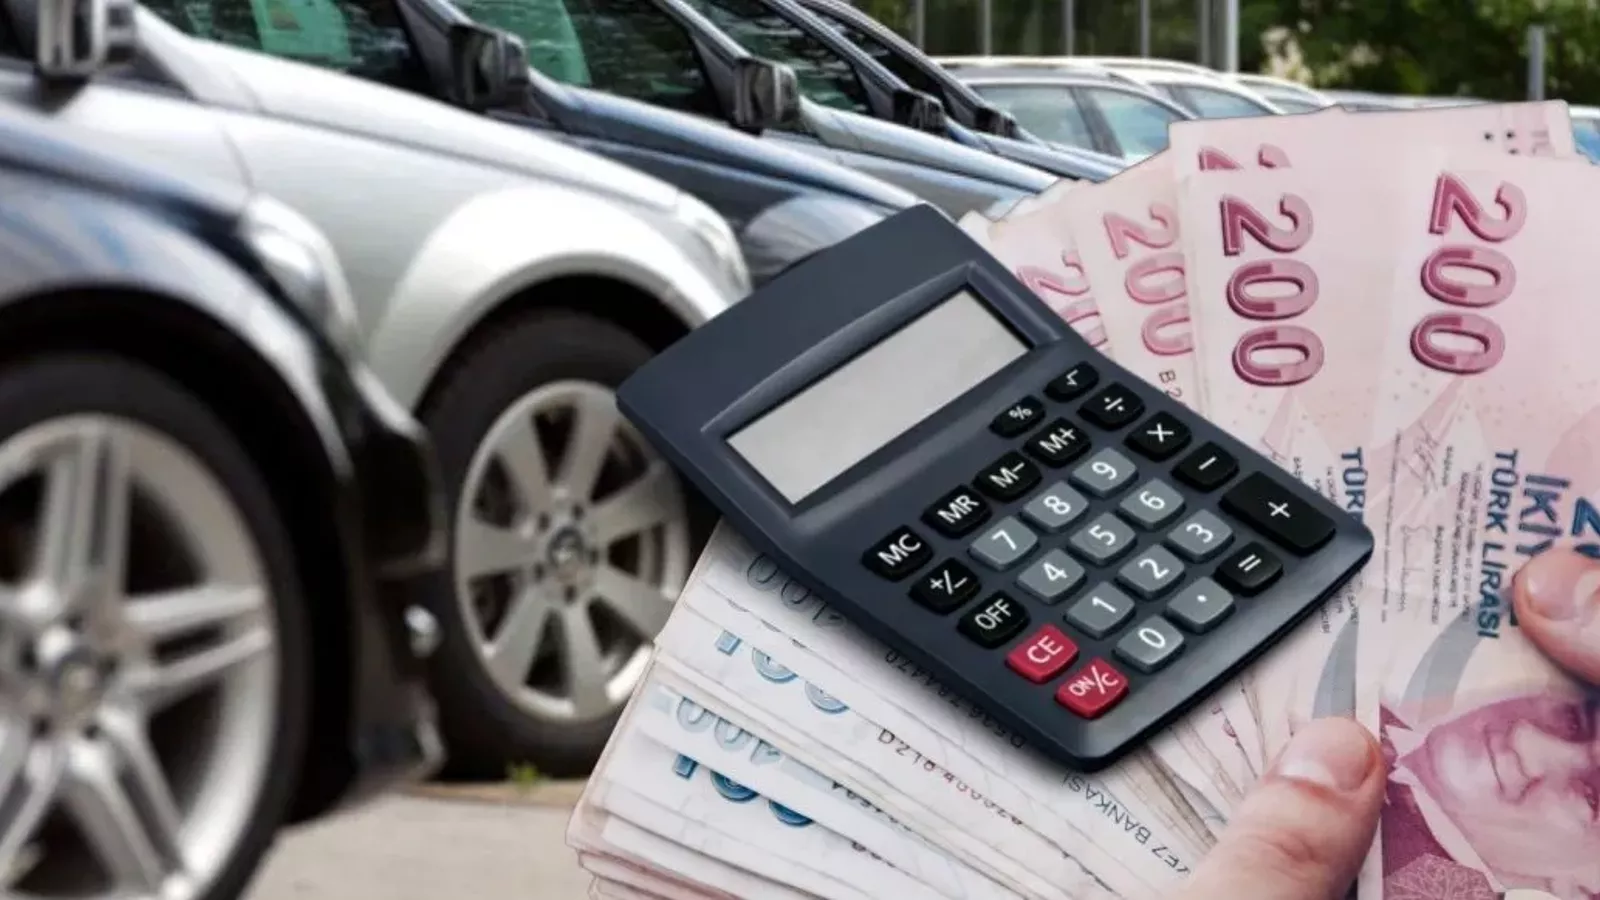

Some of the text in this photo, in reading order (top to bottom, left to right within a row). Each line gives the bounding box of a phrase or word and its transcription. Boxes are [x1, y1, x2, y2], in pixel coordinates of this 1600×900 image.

[1219, 193, 1326, 388] 200
[1410, 171, 1528, 376] 200
[877, 533, 922, 567] MC
[936, 494, 980, 524] MR
[1038, 427, 1077, 454] M+
[991, 529, 1017, 551] 7
[1043, 494, 1072, 516] 8
[1091, 461, 1118, 481] 9
[1341, 446, 1369, 513] TÜR
[1484, 448, 1520, 535] TÜRK
[973, 598, 1012, 631] OFF
[1042, 562, 1068, 582] 4
[1088, 524, 1117, 547] 5
[1138, 490, 1166, 511] 6
[1026, 635, 1064, 665] CE
[1091, 596, 1117, 614] 1
[1138, 557, 1170, 580] 2
[1185, 522, 1215, 544] 3
[1067, 665, 1119, 697] ON/C
[1137, 627, 1167, 650] 0
[1062, 771, 1153, 845] BANKASI
